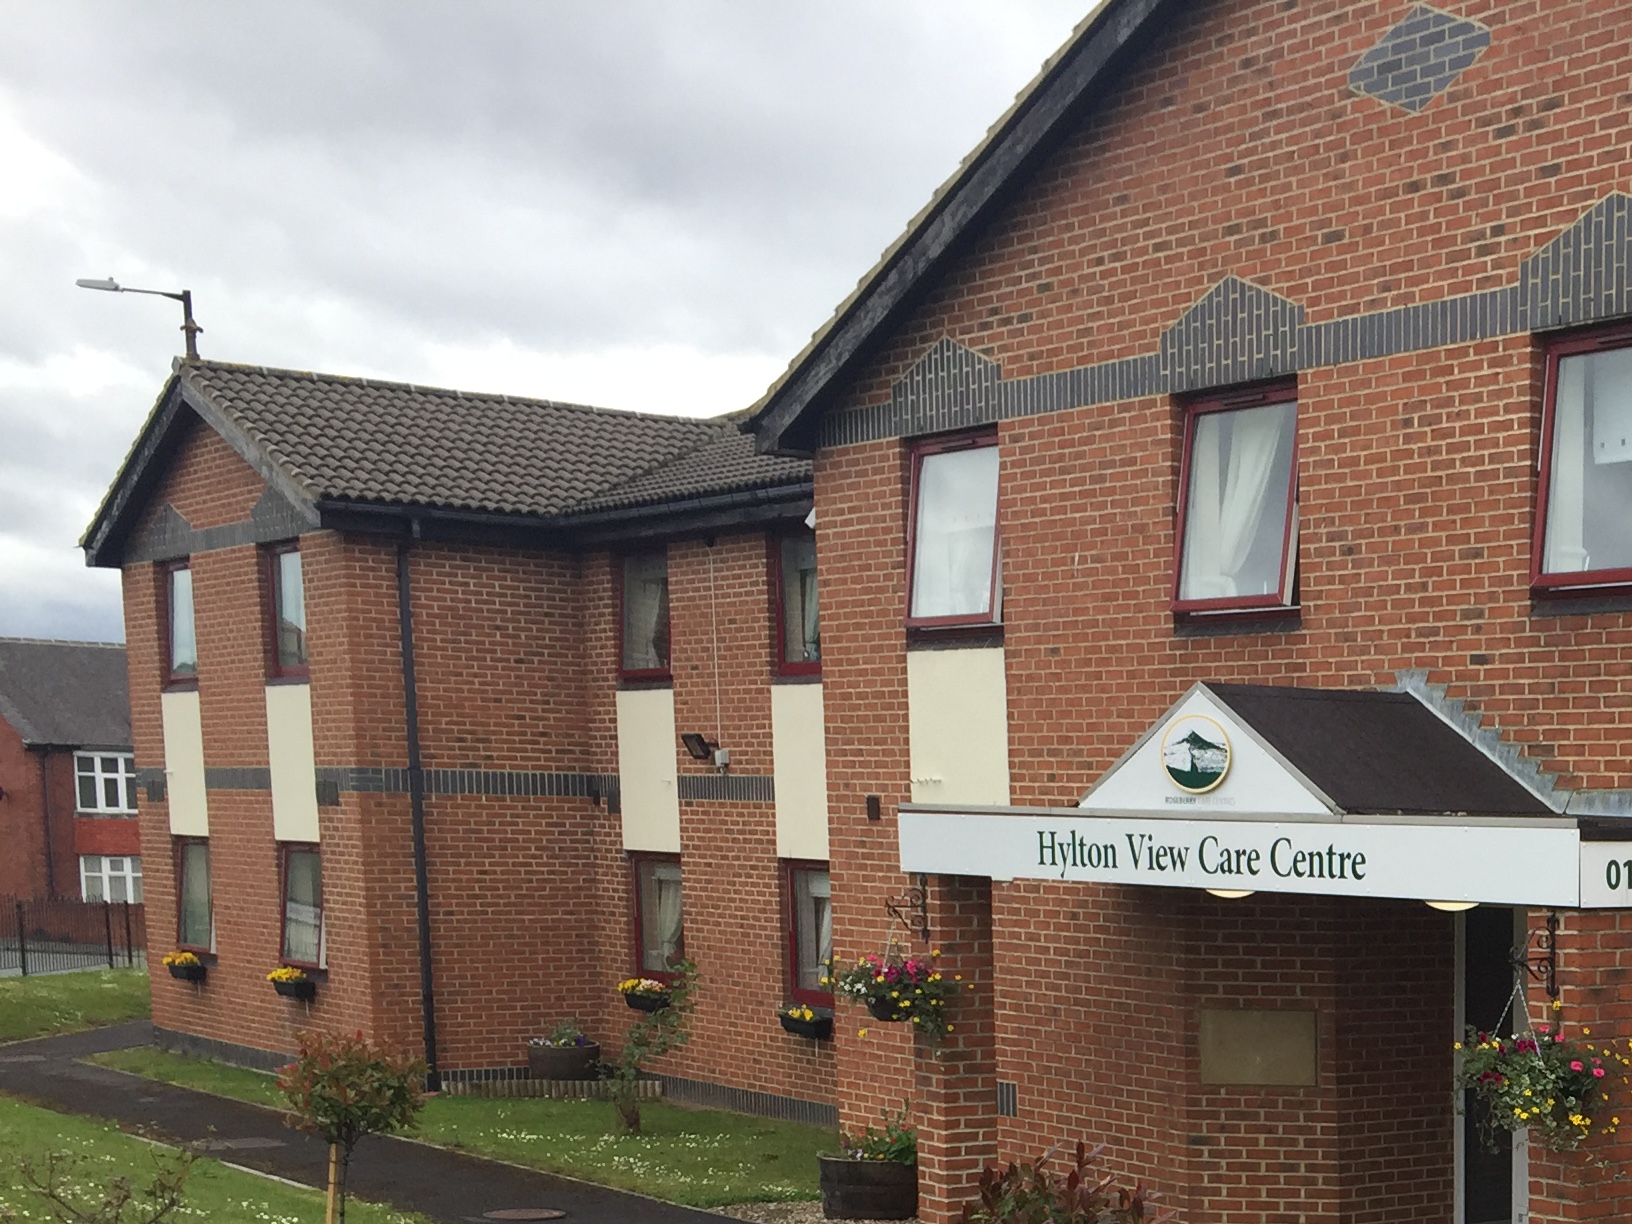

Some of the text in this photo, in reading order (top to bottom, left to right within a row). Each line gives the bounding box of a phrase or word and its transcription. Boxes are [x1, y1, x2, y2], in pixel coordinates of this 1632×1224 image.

[1036, 829, 1367, 881] Hylton View Care Centre
